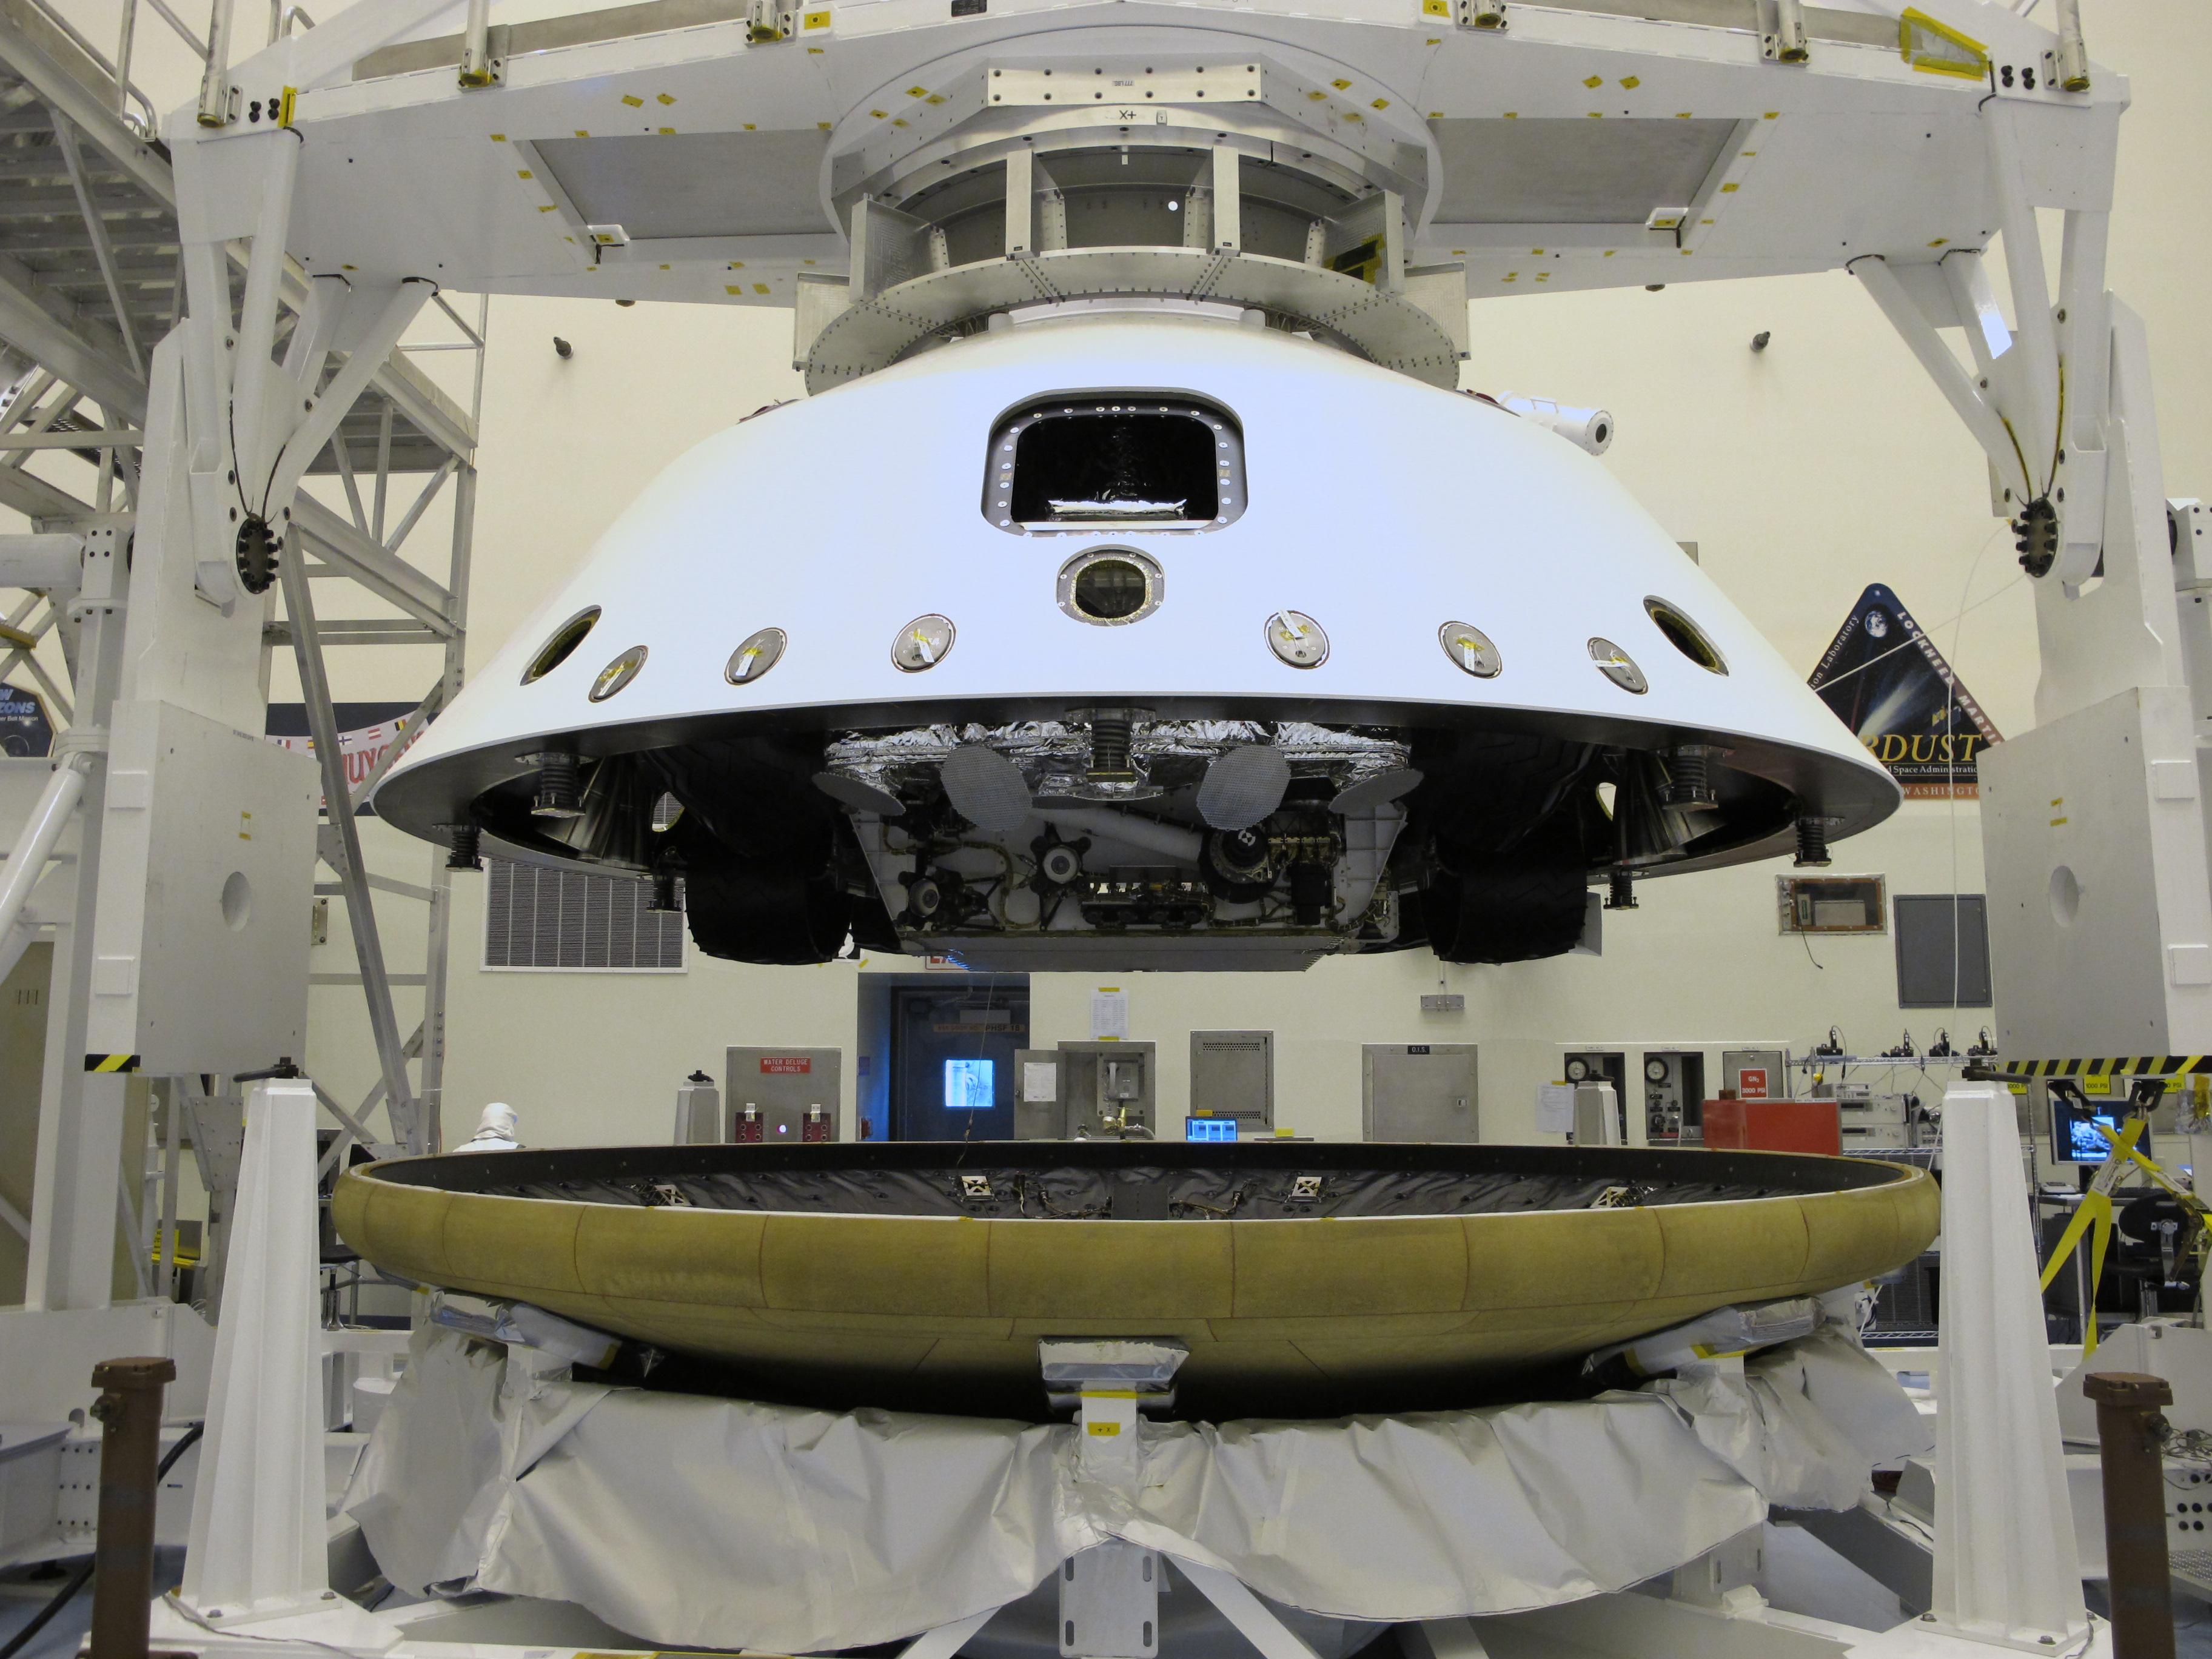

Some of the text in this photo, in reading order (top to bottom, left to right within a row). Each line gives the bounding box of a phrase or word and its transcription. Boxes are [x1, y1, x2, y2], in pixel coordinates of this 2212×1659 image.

[1820, 615, 1860, 669] Laboratory
[1897, 611, 1956, 686] LOCKHEED
[1894, 765, 1919, 775] Space
